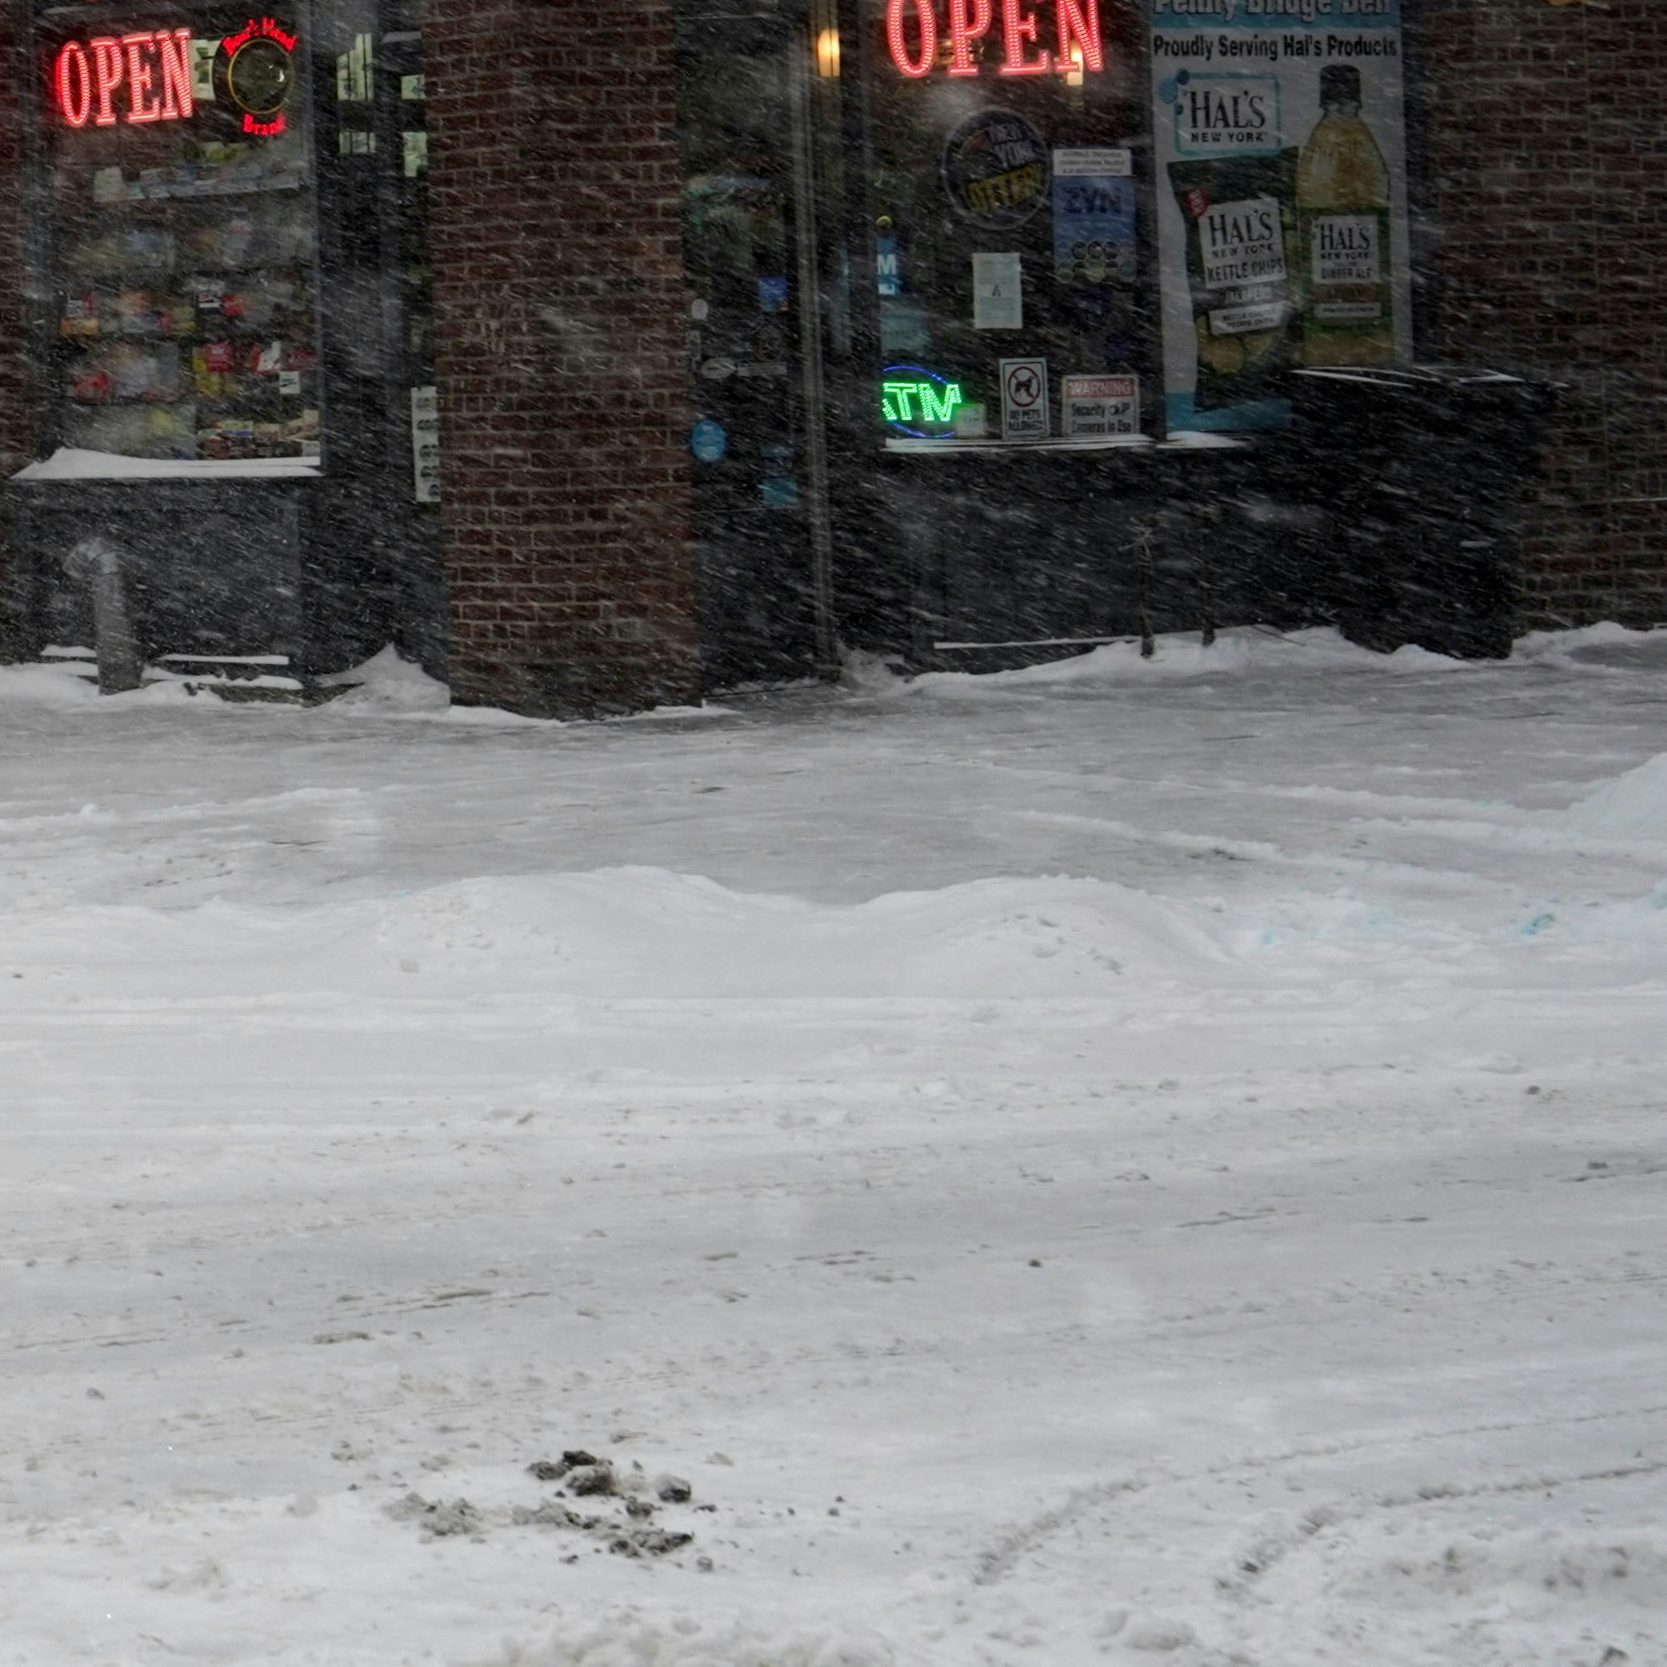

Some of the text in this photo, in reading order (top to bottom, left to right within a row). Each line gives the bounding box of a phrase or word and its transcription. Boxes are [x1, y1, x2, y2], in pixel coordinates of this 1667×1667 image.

[1153, 34, 1398, 61] Proudly Serving Hal's Products
[55, 27, 193, 128] OPEN
[1189, 90, 1266, 129] HAL'S
[1191, 132, 1264, 143] NEW YORK
[1208, 209, 1273, 248] HAL'S
[1320, 223, 1370, 251] HAL'S
[1212, 244, 1274, 259] NEW YORK
[1207, 258, 1284, 283] KETTLE CHIPS
[1068, 380, 1132, 396] WARNING
